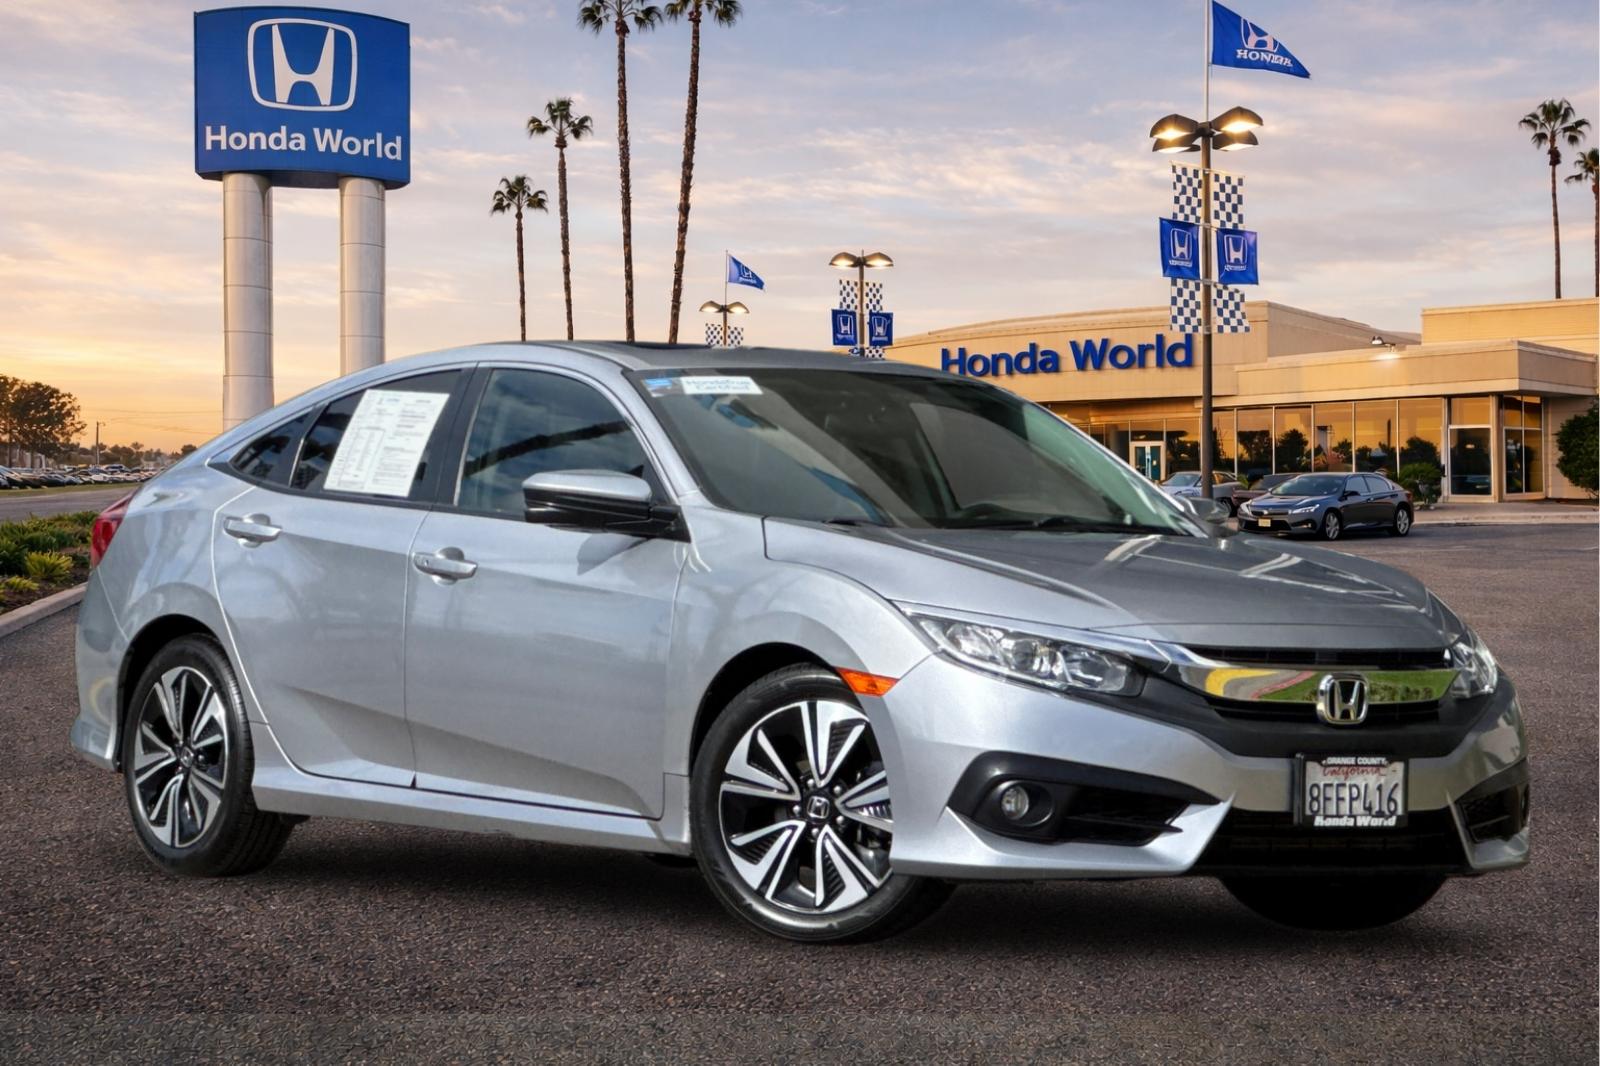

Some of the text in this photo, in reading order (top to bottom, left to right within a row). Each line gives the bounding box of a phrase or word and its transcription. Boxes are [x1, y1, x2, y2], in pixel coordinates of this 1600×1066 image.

[205, 125, 402, 161] Honda World
[940, 333, 1194, 377] Honda World
[1308, 783, 1400, 816] 8FFP416
